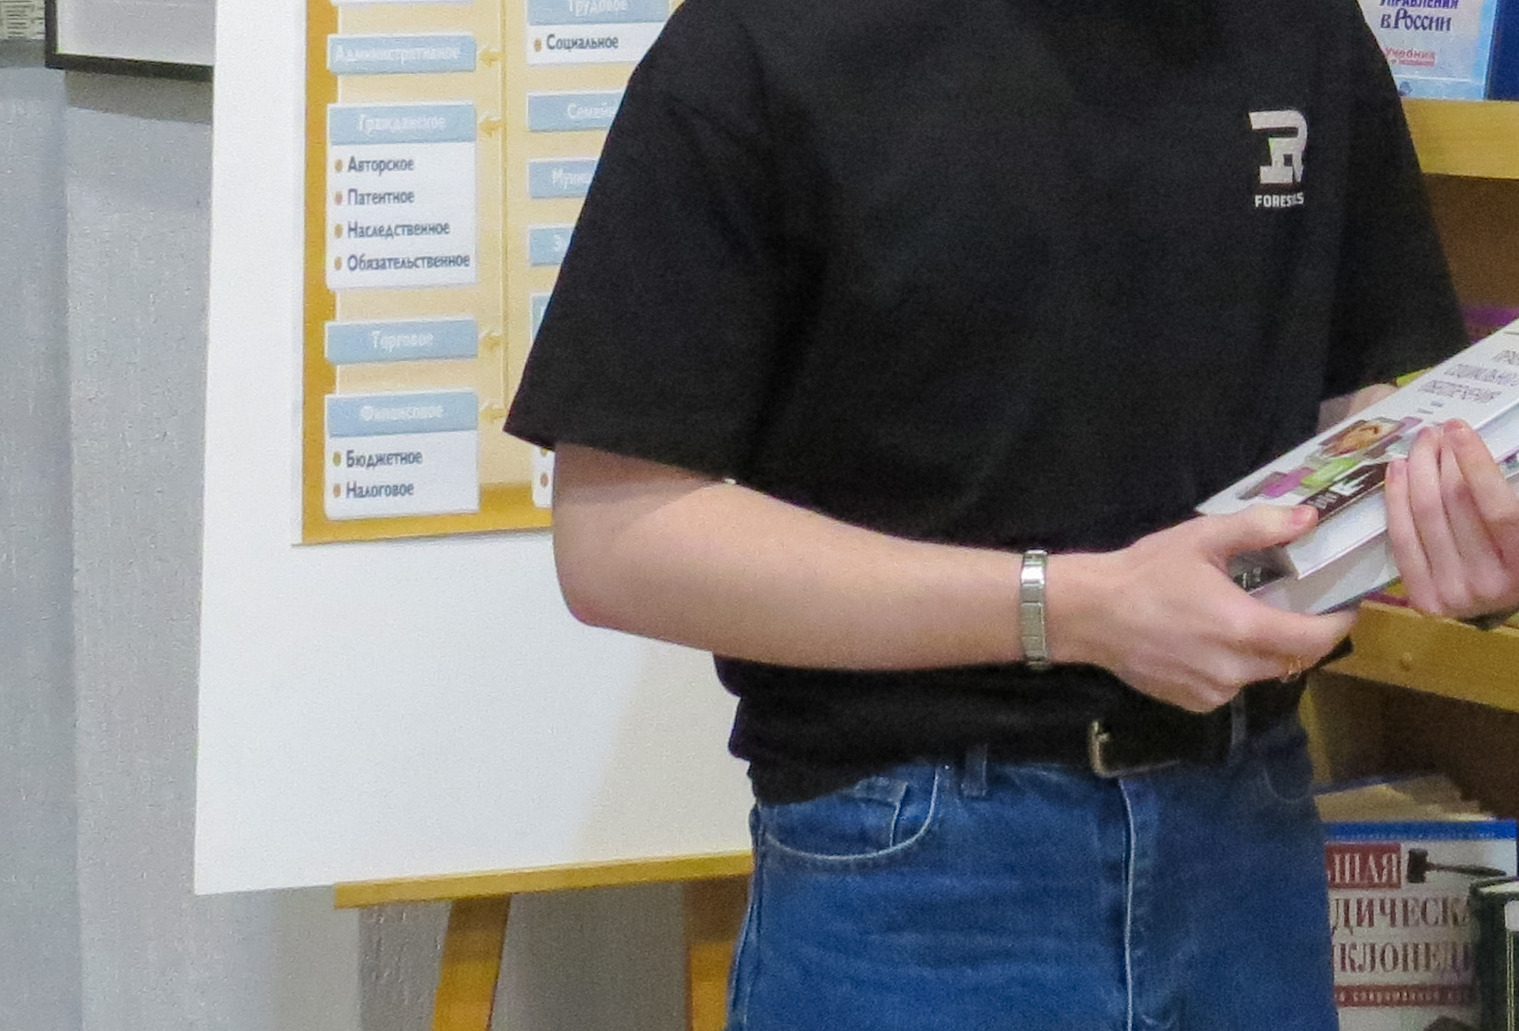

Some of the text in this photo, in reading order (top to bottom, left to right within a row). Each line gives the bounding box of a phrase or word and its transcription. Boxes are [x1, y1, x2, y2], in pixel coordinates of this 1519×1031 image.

[1380, 8, 1452, 32] в России
[546, 34, 619, 52] Социальное
[347, 156, 415, 176] Авторское
[347, 188, 416, 206] Патентное
[347, 221, 451, 239] Наследственное
[347, 253, 471, 271] Обязательственное
[346, 450, 423, 470] Бюджетное
[346, 481, 415, 499] Налоговое
